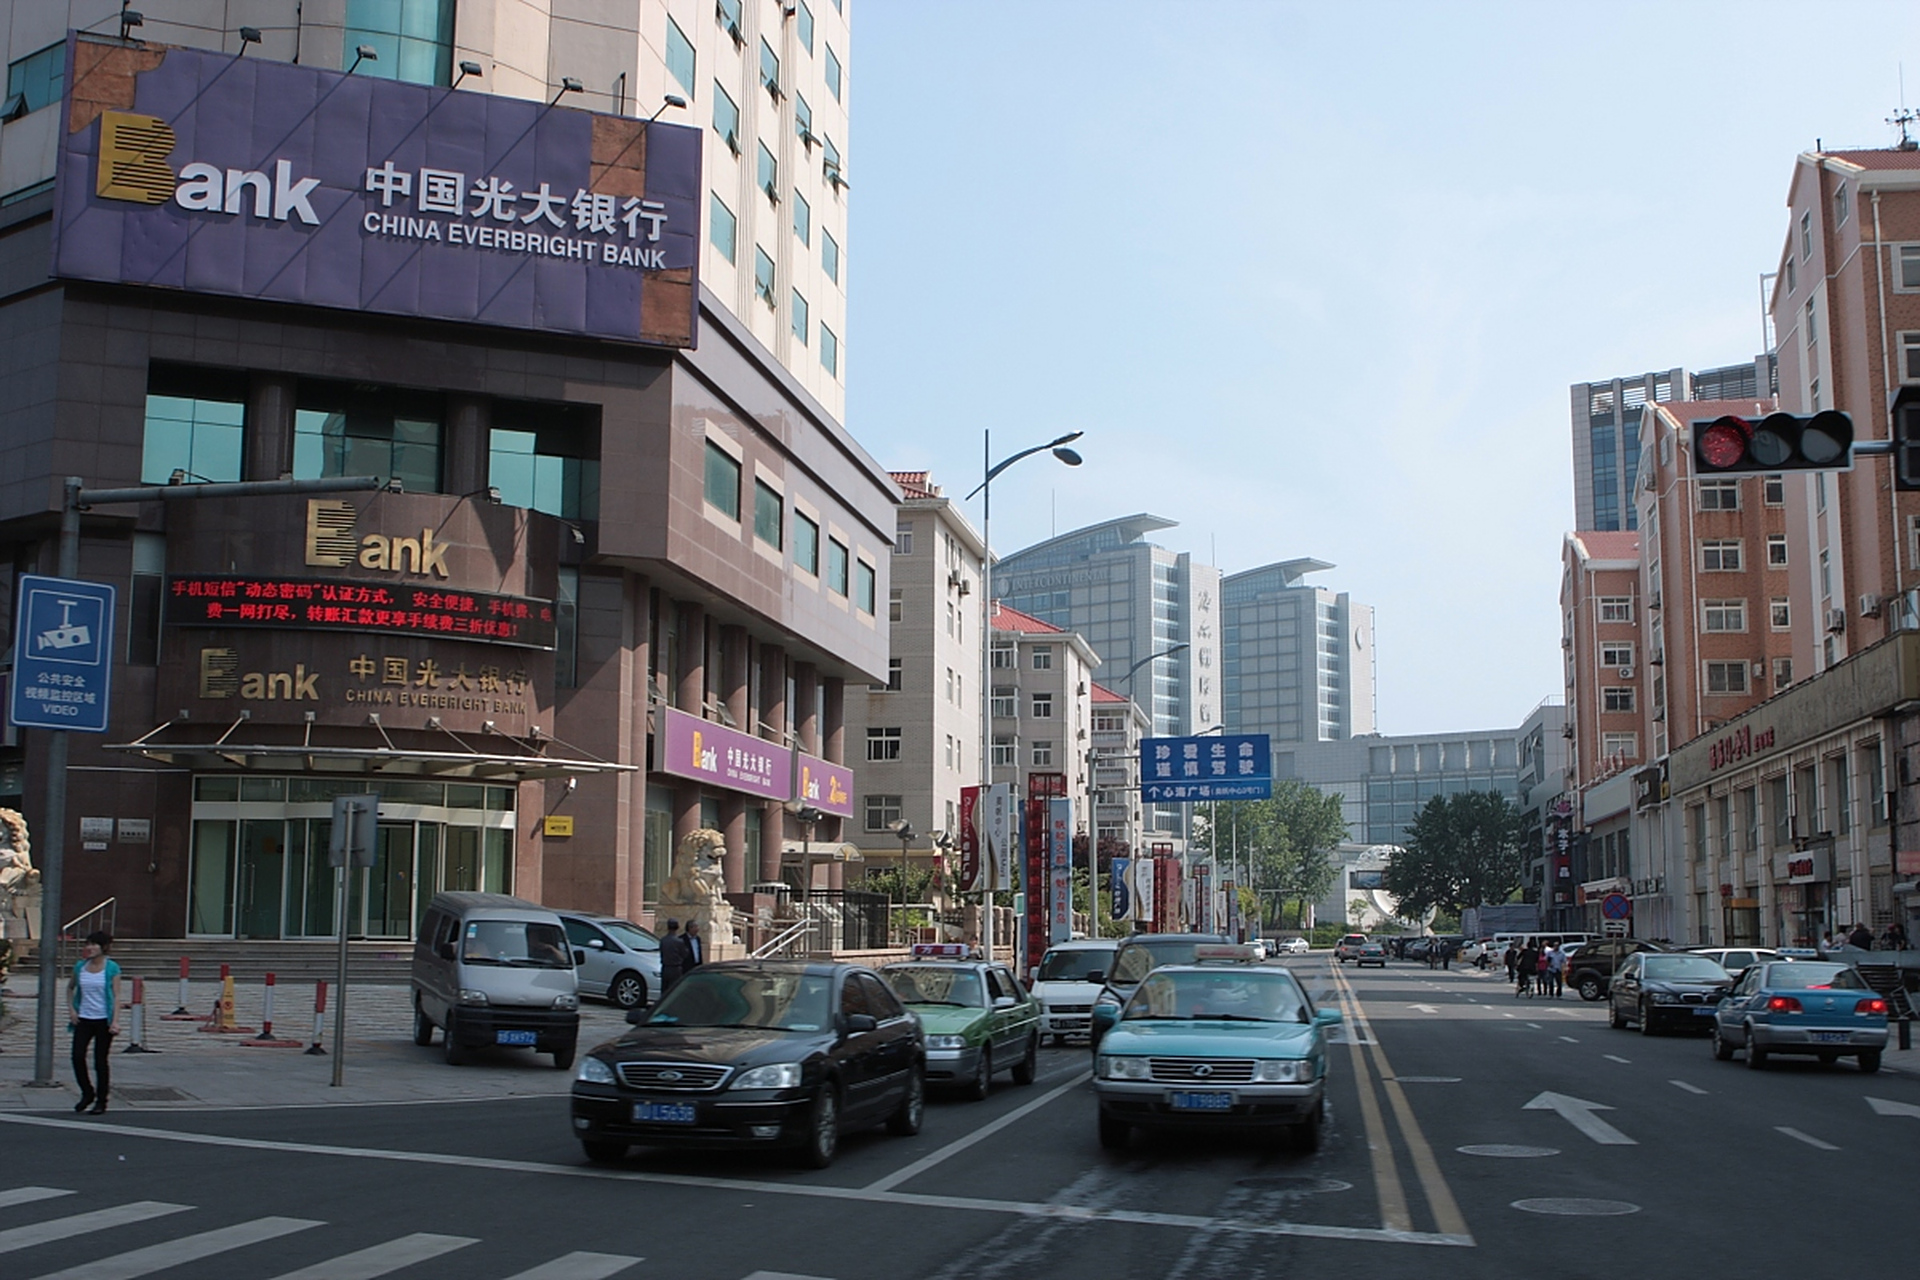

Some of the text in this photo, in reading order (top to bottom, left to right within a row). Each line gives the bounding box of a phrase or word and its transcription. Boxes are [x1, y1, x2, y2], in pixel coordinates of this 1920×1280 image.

[96, 109, 321, 225] Bank
[366, 160, 668, 242] 中国光大银行
[364, 211, 667, 269] CHINA EVERBRIGHT BANK
[305, 499, 449, 578] Bank
[38, 672, 85, 687] 公共安全
[200, 648, 320, 700] Bank
[350, 654, 527, 695] 中国光大银行
[25, 687, 96, 704] 视频监控区域
[42, 704, 78, 716] VIDEO
[346, 689, 526, 714] CHINA EVERBRIGHT BANK
[693, 731, 717, 772] Bank
[727, 746, 771, 776] 中国光大银行
[1155, 742, 1254, 760] 珍爱生命
[1156, 760, 1255, 777] 谨慎驾驶
